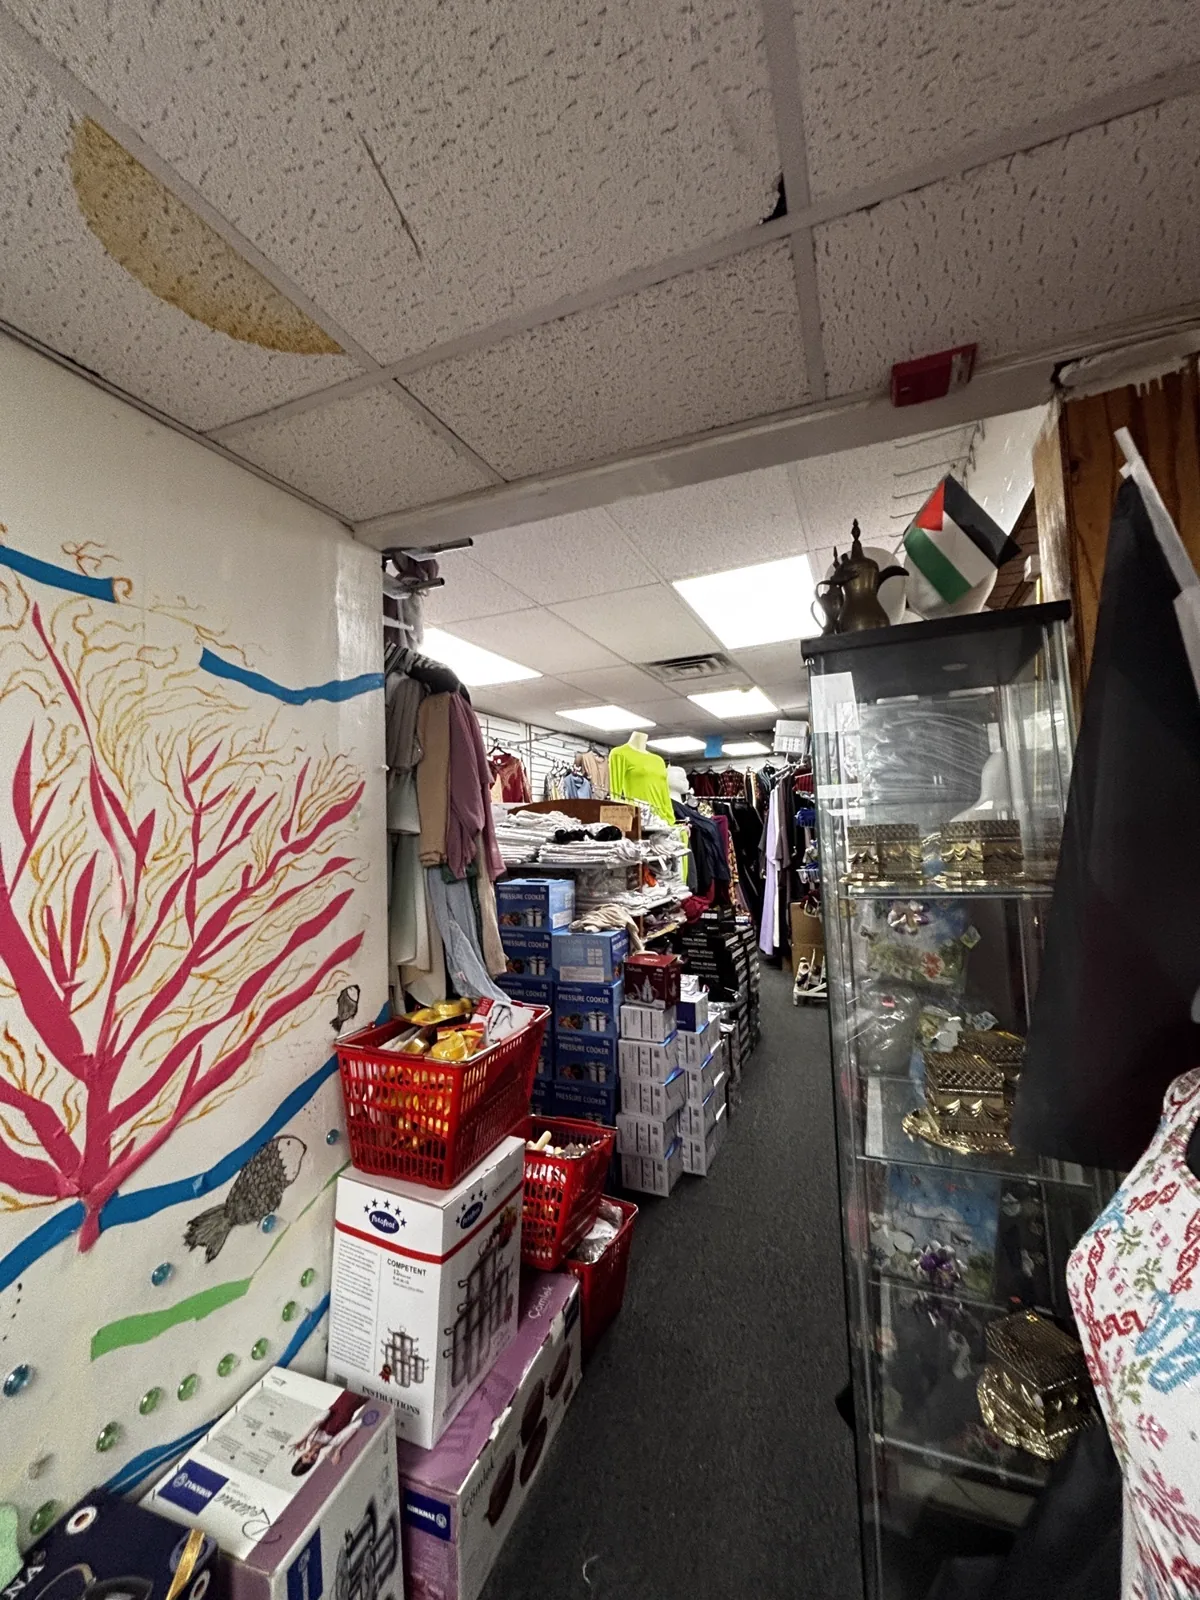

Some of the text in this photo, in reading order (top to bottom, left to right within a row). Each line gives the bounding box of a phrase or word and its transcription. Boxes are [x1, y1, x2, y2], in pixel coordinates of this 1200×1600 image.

[528, 941, 549, 949] COOKER
[558, 993, 609, 1004] PRESSURE COOKER
[558, 1042, 609, 1055] PRESSURE COOKER
[555, 1092, 607, 1106] PRESSURE COOKER
[387, 1258, 427, 1277] COMPETENT
[362, 1385, 420, 1415] INSTRUCTIONS
